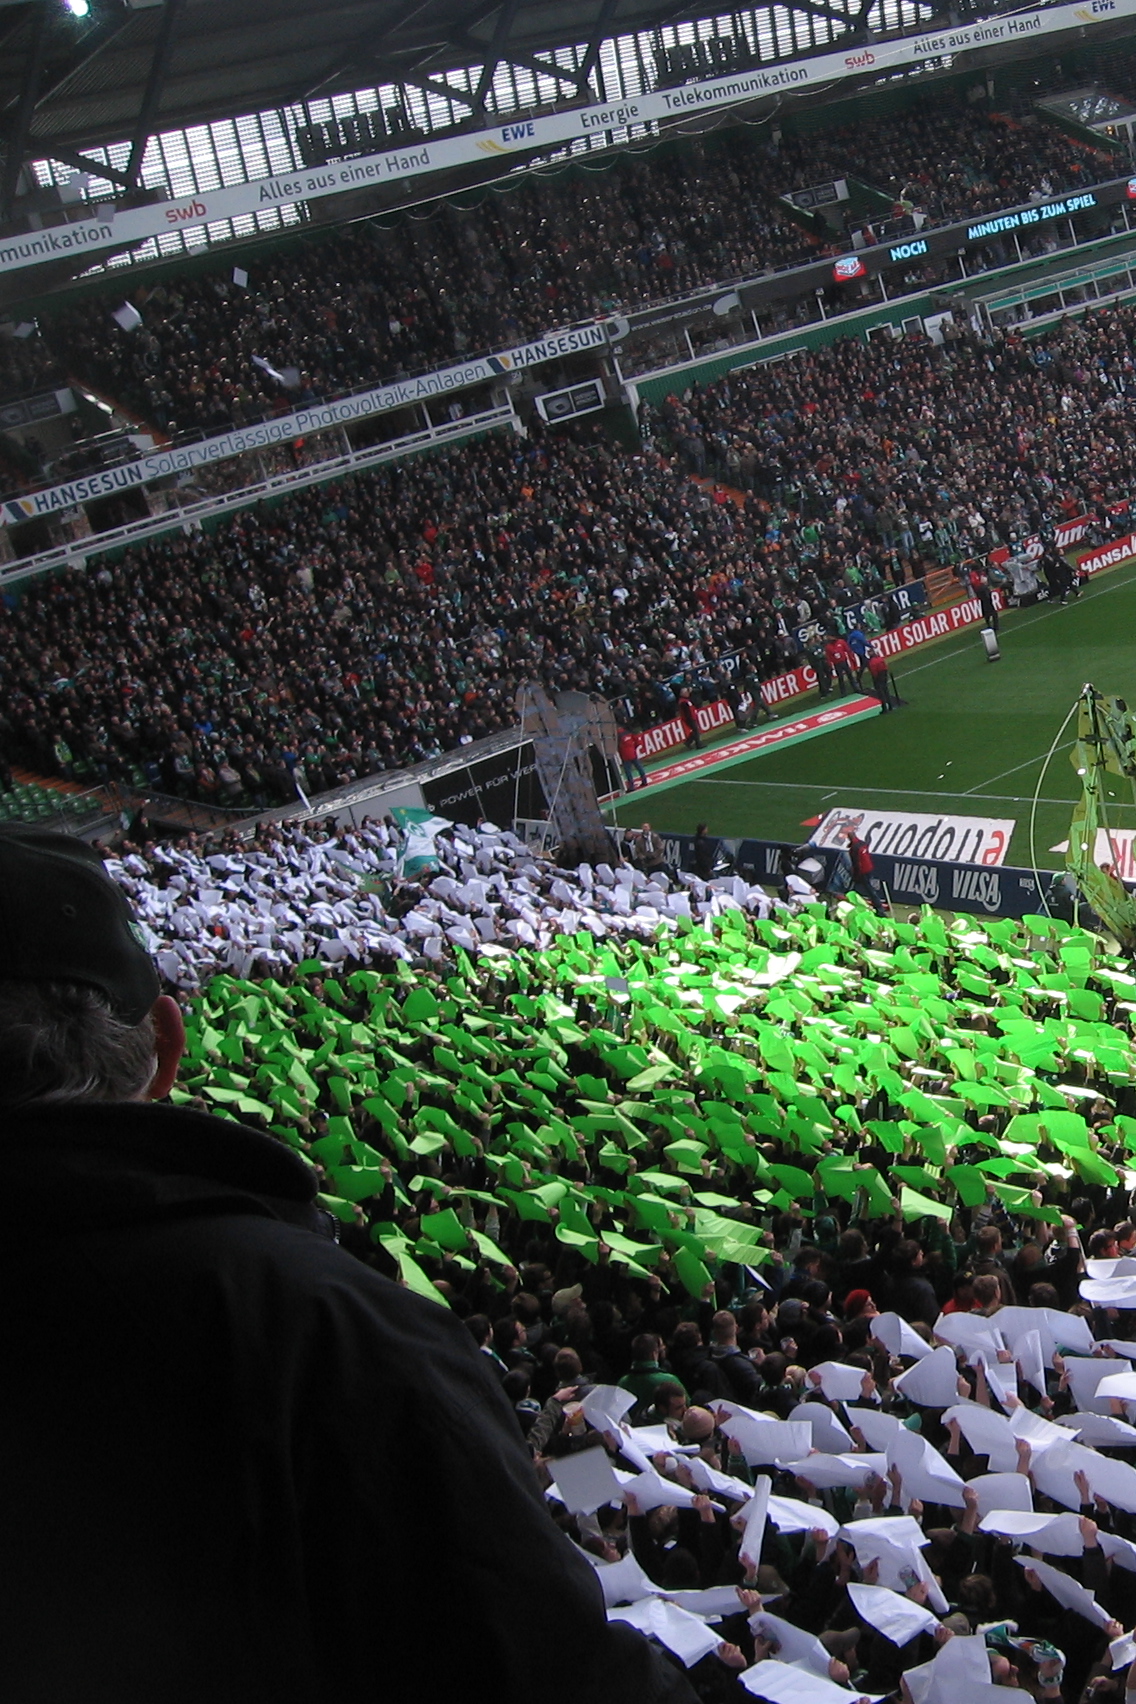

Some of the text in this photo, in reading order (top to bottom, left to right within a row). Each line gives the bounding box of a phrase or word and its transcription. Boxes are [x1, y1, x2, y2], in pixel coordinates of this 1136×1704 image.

[165, 200, 207, 223] swb
[259, 180, 302, 202] Alles
[307, 172, 336, 191] aus
[340, 161, 383, 184] einer
[386, 149, 431, 172] Hand
[501, 122, 536, 143] EWE
[580, 104, 639, 128] Energie
[662, 66, 809, 109] Telekommunikation
[845, 51, 876, 69] swb
[914, 35, 946, 55] Alles
[949, 30, 971, 47] aus
[974, 23, 1005, 41] einer
[1008, 15, 1041, 33] Hand
[890, 194, 1097, 261] NOCH MINUTEN BIS ZUM SPIEL
[34, 465, 143, 513] HANSESUN
[511, 327, 602, 367] HANSESUN
[865, 631, 901, 659] RTH
[903, 611, 948, 646] SOLAR
[951, 591, 1002, 628] POWR
[697, 703, 734, 733] OLA
[440, 785, 483, 807] POWER
[894, 862, 940, 904] VILSA
[952, 869, 1001, 912] VILSA
